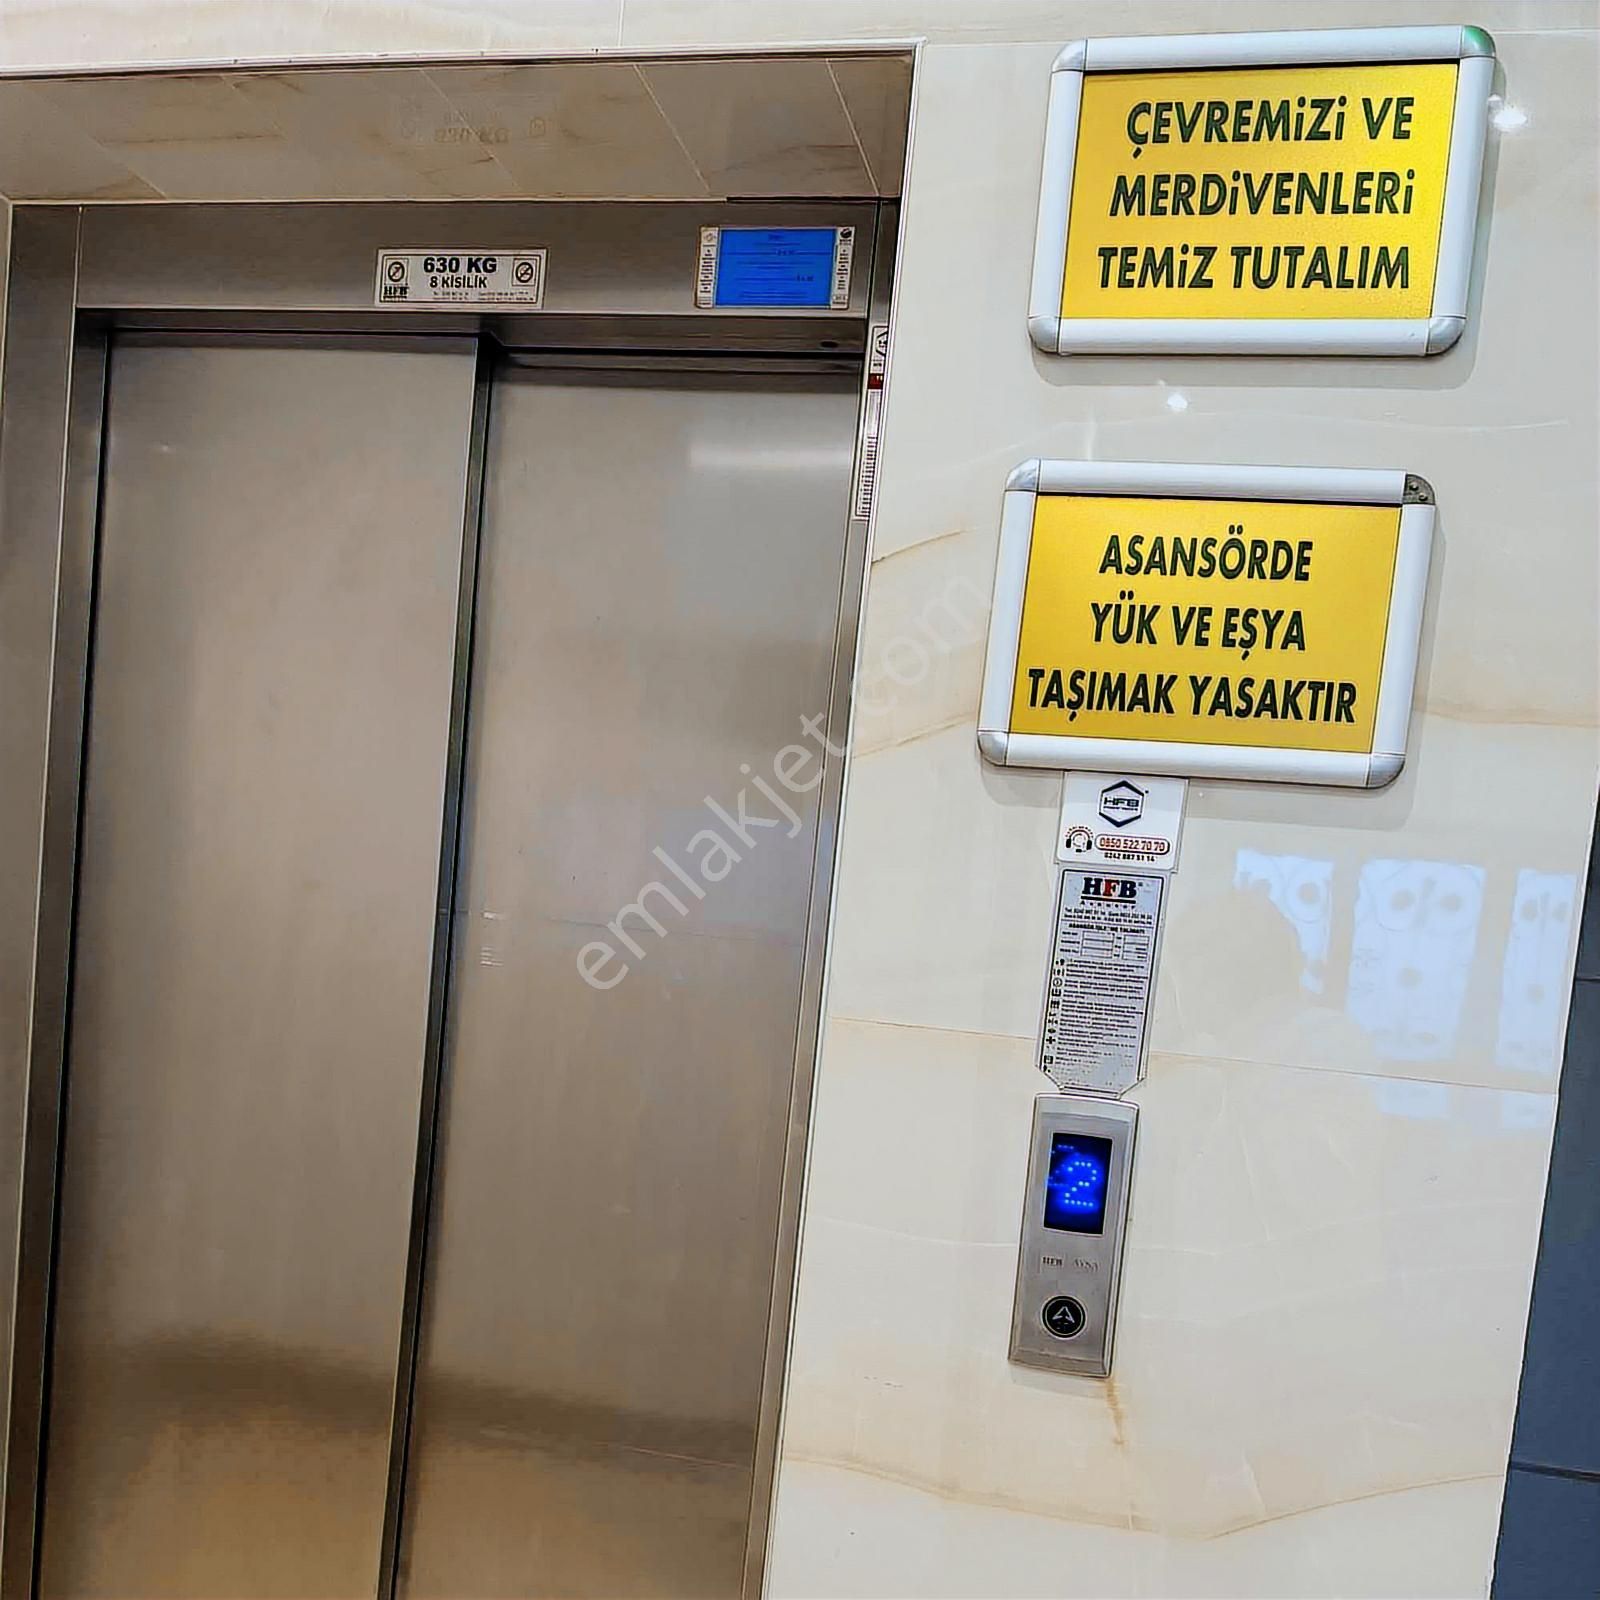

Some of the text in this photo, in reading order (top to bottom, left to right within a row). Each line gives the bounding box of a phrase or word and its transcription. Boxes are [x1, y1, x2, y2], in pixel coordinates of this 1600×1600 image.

[1361, 97, 1415, 140] VE
[423, 256, 497, 274] 630 KG
[429, 276, 438, 289] 8
[1231, 245, 1410, 289] TUTALIM
[1099, 524, 1313, 582] ASANSÖRDE
[1091, 590, 1306, 660] YÜK VE EŞYA
[1028, 668, 1357, 724] TAŞIMAK YASAKTIR
[1103, 796, 1140, 807] HFB
[1099, 837, 1165, 852] 0850 522 70 70
[1082, 876, 1137, 899] HFB
[1064, 1160, 1097, 1208] 2
